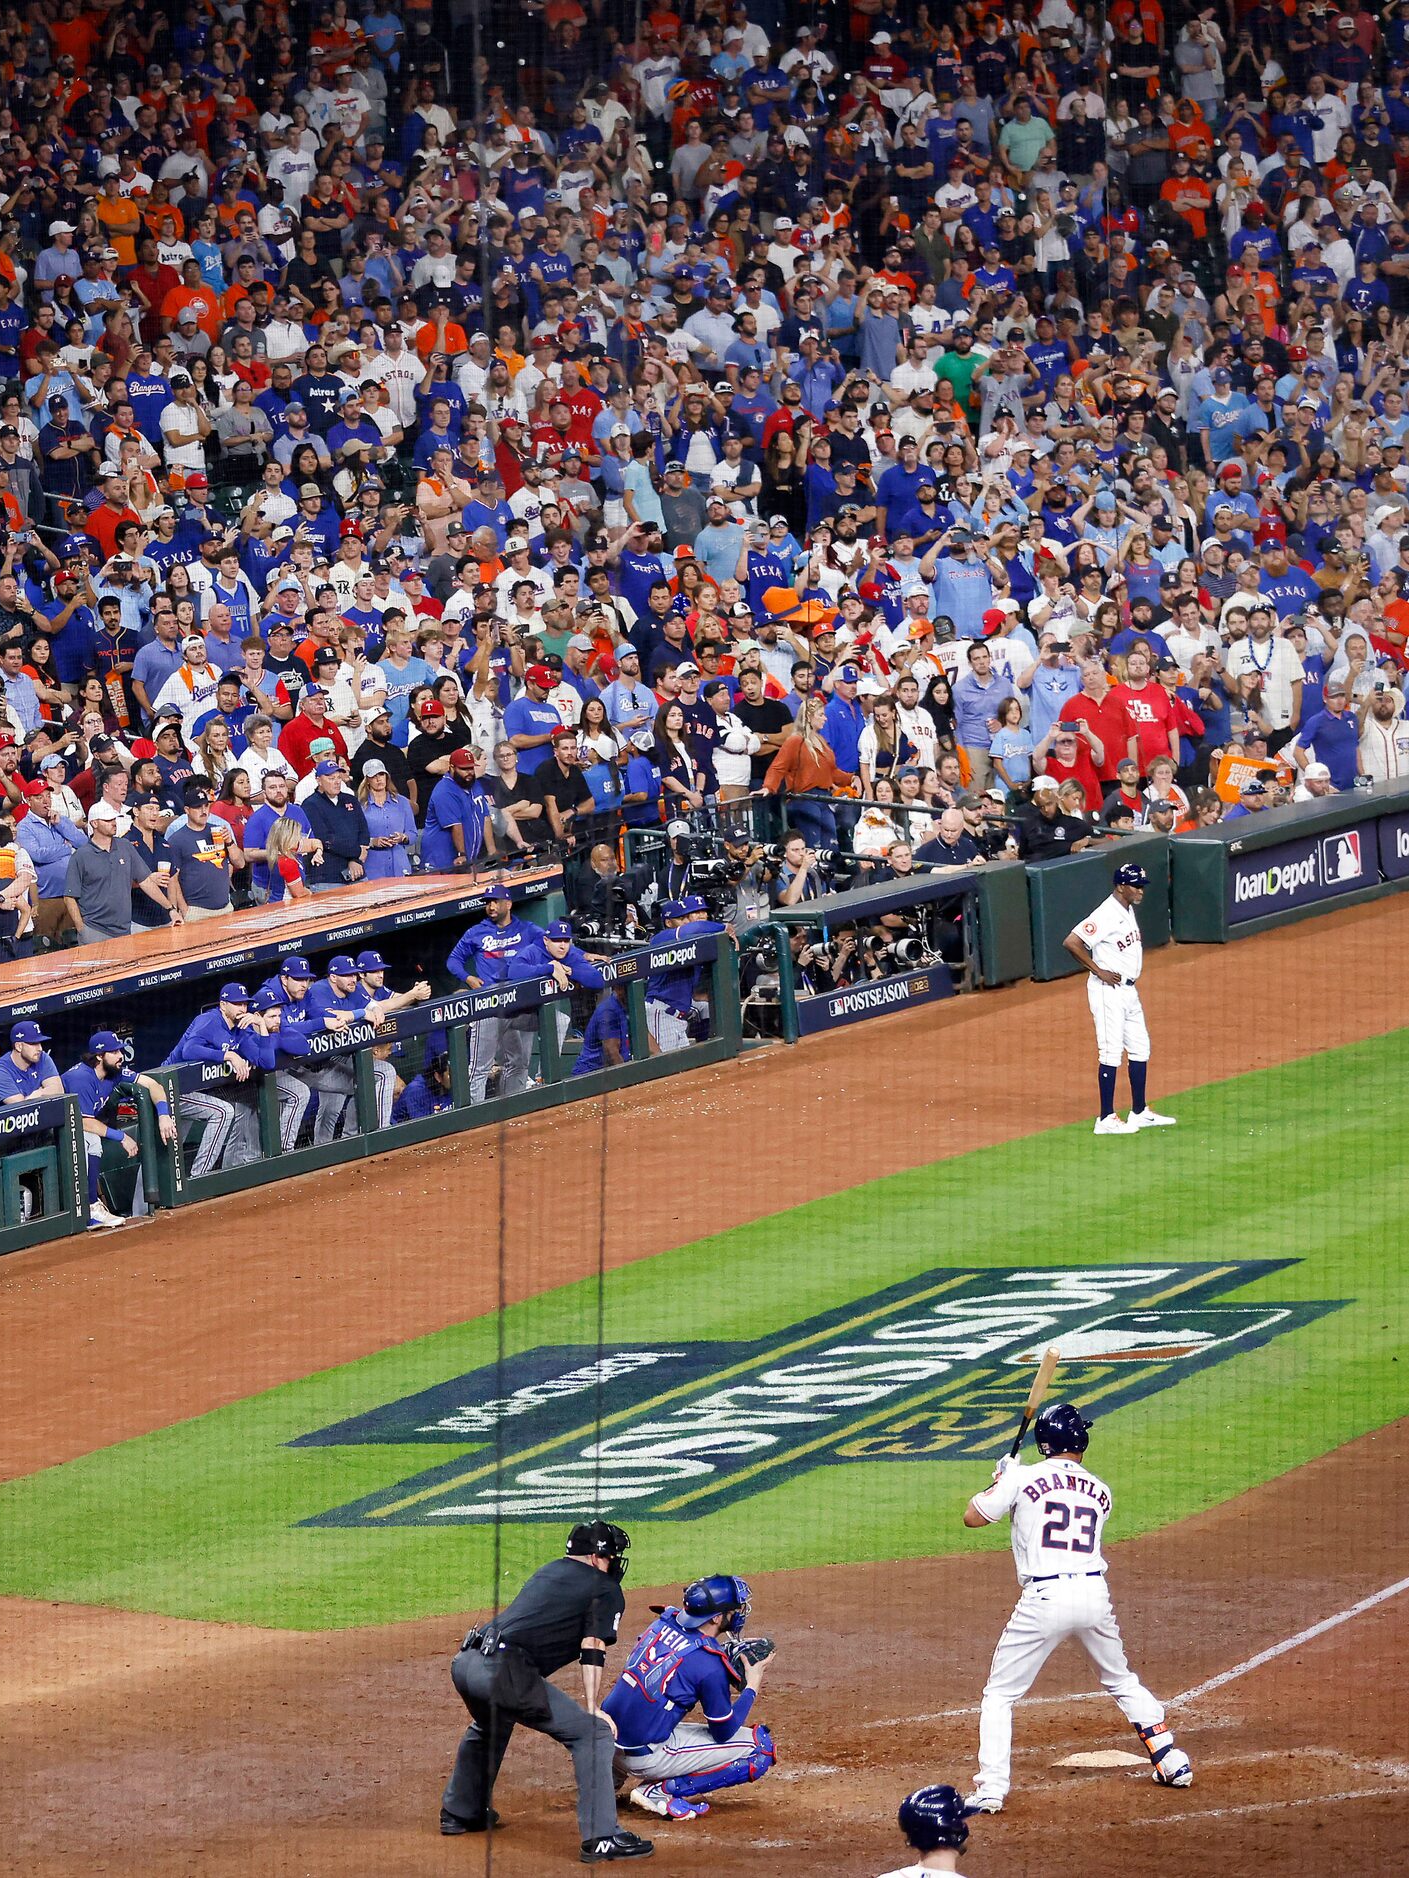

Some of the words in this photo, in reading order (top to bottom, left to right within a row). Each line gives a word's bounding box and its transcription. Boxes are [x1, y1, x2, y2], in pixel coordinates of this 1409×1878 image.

[130, 380, 166, 397] Rangers
[309, 388, 336, 398] Astros
[1268, 585, 1307, 601] TEXAS
[1235, 850, 1316, 904] loanDepot
[525, 882, 548, 894] loanDepot
[415, 908, 435, 921] loanDepot
[333, 925, 364, 941] POSTSEASON
[278, 940, 303, 953] loanDepot
[481, 933, 522, 952] Rangers
[213, 954, 245, 968] POSTSEASON
[650, 943, 697, 969] loanDepot
[617, 961, 637, 975] 2023
[145, 974, 158, 986] ALCS
[161, 970, 182, 983] loanDepot
[71, 987, 103, 1003] POSTSEASON
[843, 980, 910, 1014] POSTSEASON
[909, 979, 929, 993] 2023
[12, 1003, 38, 1016] loanDepot
[443, 1000, 469, 1022] ALCS
[474, 988, 517, 1011] loanDepot
[376, 1021, 397, 1035] 2023
[70, 1104, 82, 1218] ASTROS.COM
[414, 1351, 687, 1434] loanDepot
[427, 1268, 1180, 1517] POSTSEASON
[1023, 1473, 1112, 1515] BRANTLEY
[1041, 1500, 1098, 1554] 23
